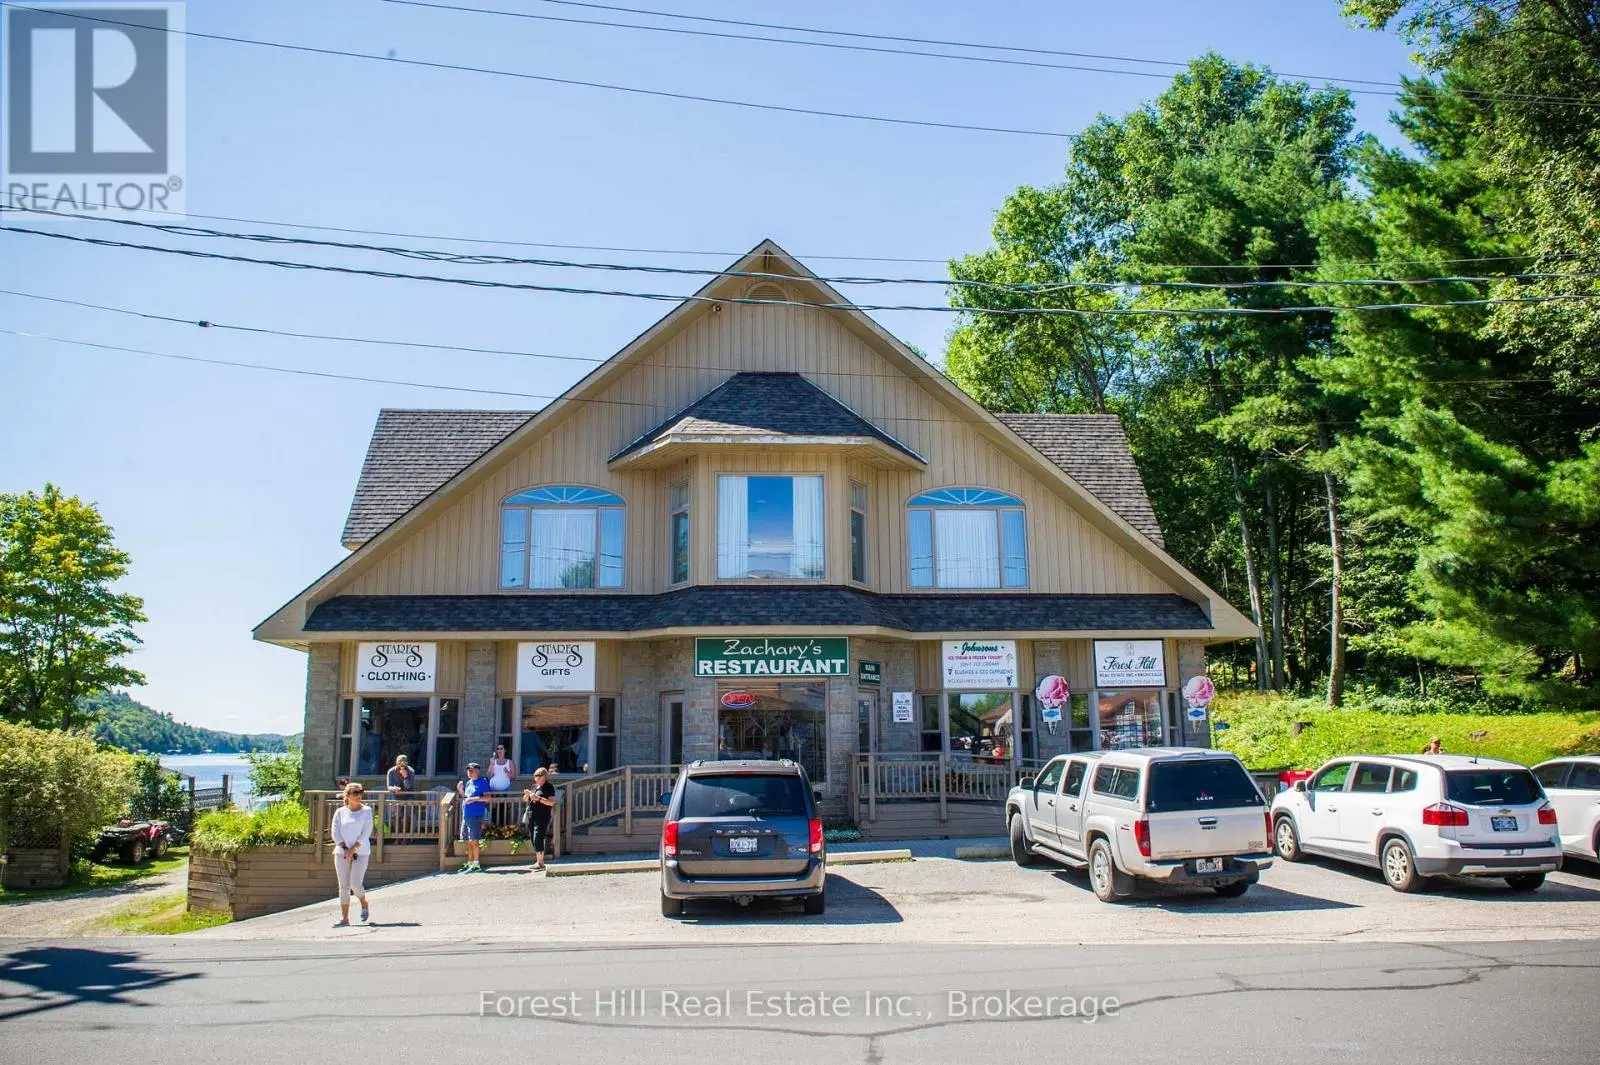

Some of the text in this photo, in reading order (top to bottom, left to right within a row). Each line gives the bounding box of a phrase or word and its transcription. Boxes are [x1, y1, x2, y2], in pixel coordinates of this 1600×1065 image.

[370, 644, 423, 668] STARES
[531, 644, 583, 668] STARES
[722, 639, 822, 659] Zachary's
[699, 659, 846, 675] RESTAURANT
[1103, 656, 1157, 670] Forest Hill
[367, 671, 426, 681] CLOTHING
[541, 668, 571, 676] GIFTS
